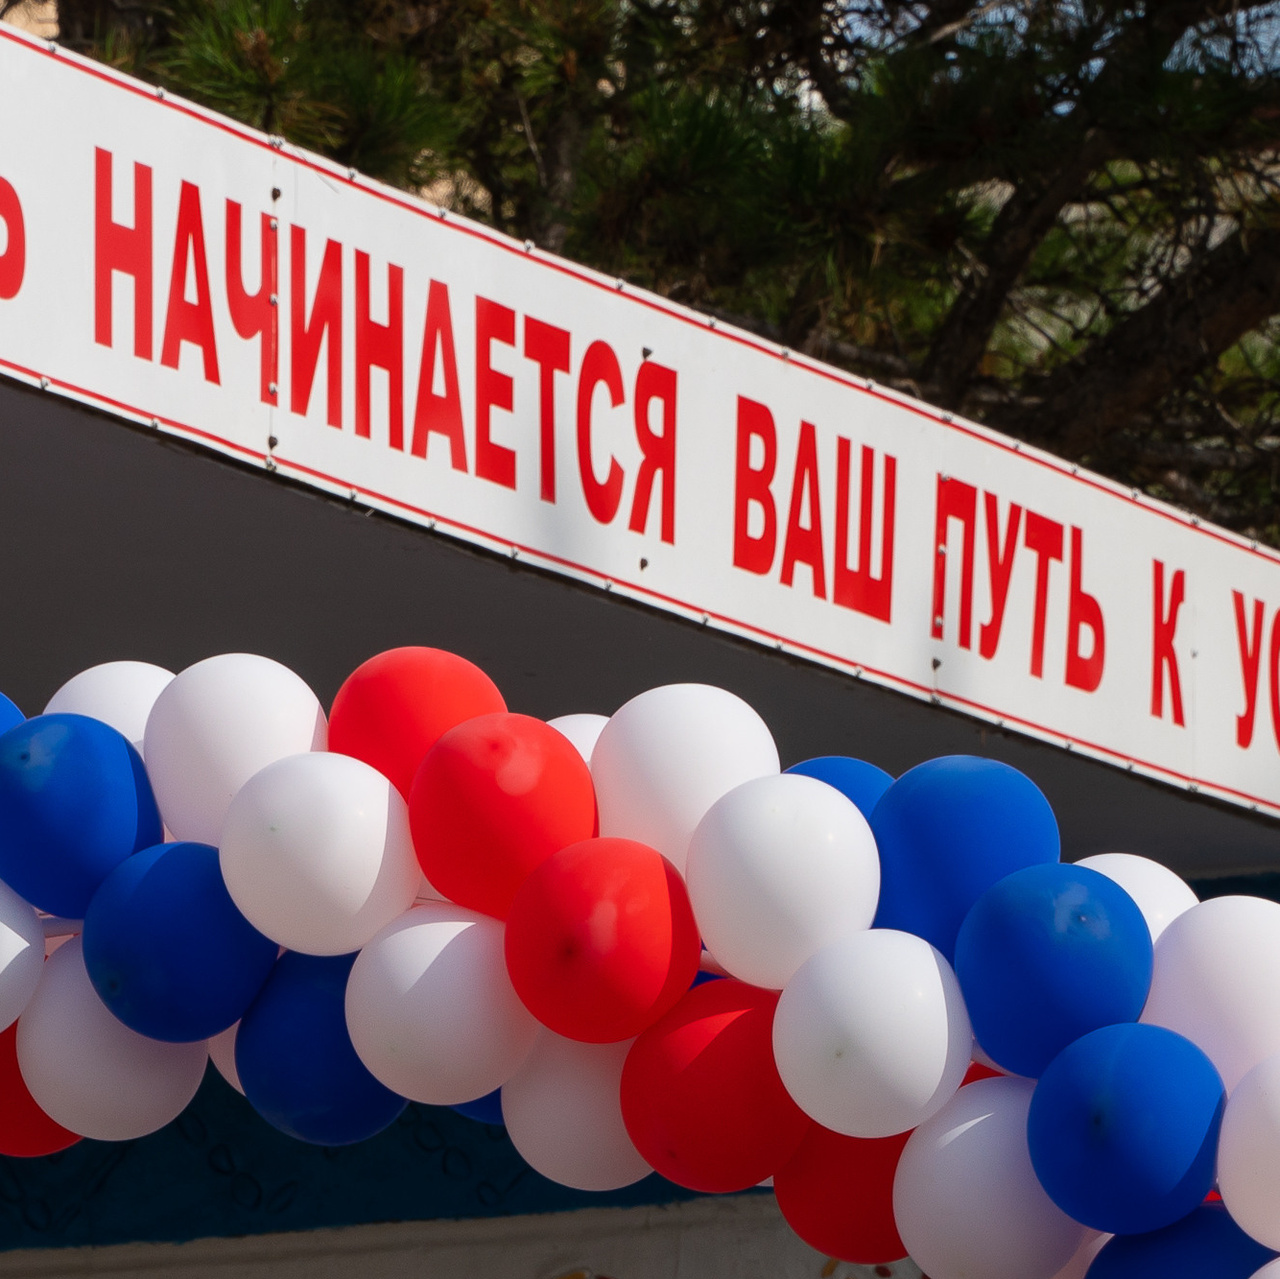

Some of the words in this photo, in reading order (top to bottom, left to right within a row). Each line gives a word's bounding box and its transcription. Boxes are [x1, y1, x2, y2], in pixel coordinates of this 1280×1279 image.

[94, 146, 678, 546] НАЧИНАЕТСЯ
[732, 394, 897, 625] ВАШ
[930, 472, 1106, 694] ПУТЬ
[1150, 558, 1186, 728] К
[1231, 589, 1280, 765] У
